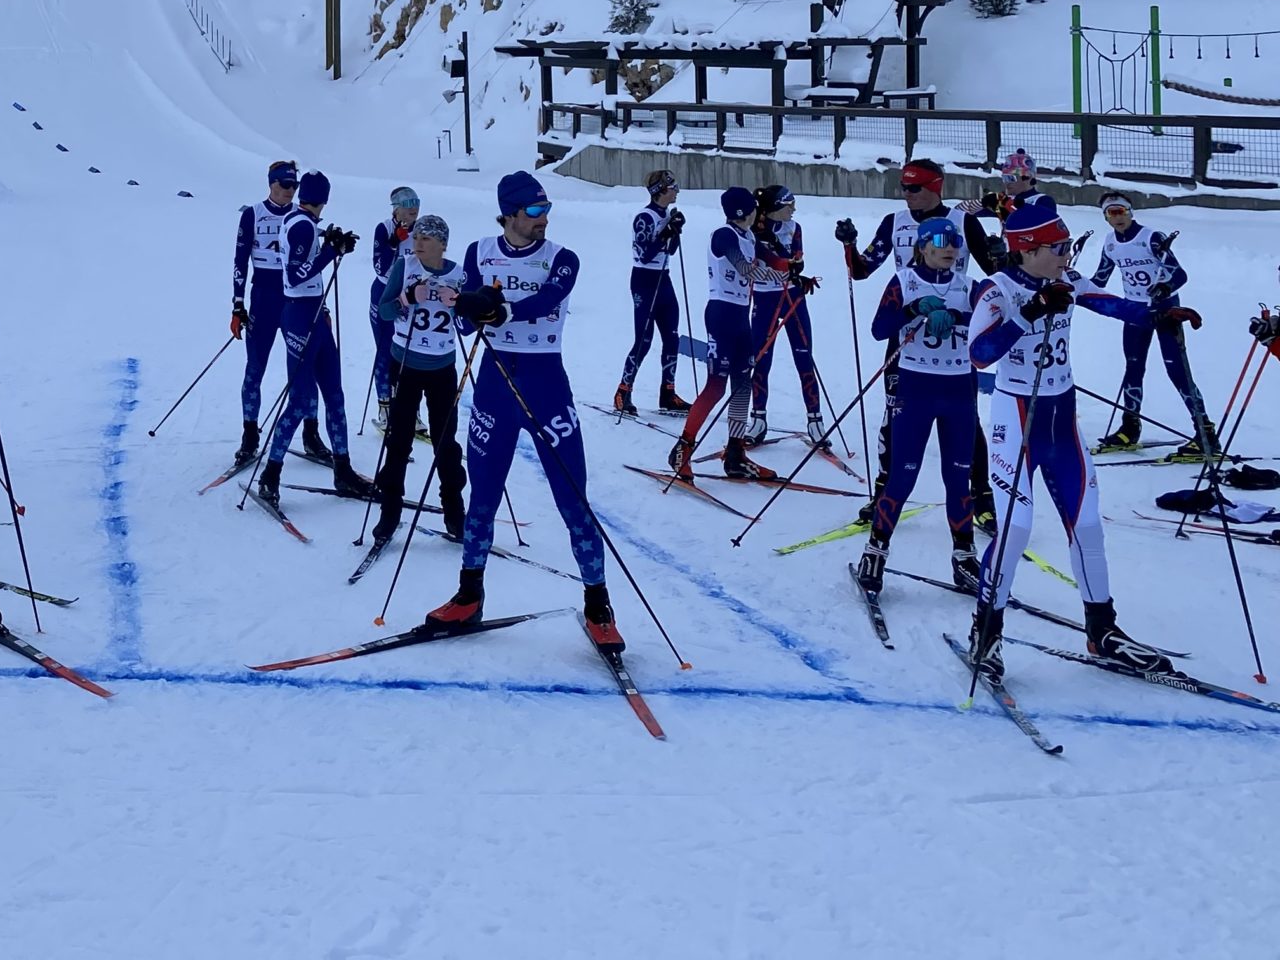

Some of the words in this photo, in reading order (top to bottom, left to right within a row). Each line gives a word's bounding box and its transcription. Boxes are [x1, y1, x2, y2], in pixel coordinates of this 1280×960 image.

[1125, 270, 1151, 287] 39
[414, 308, 451, 334] 32
[1033, 338, 1067, 369] 33
[993, 424, 1007, 432] US
[991, 451, 1017, 476] xfinity
[991, 472, 1033, 507] BOSE
